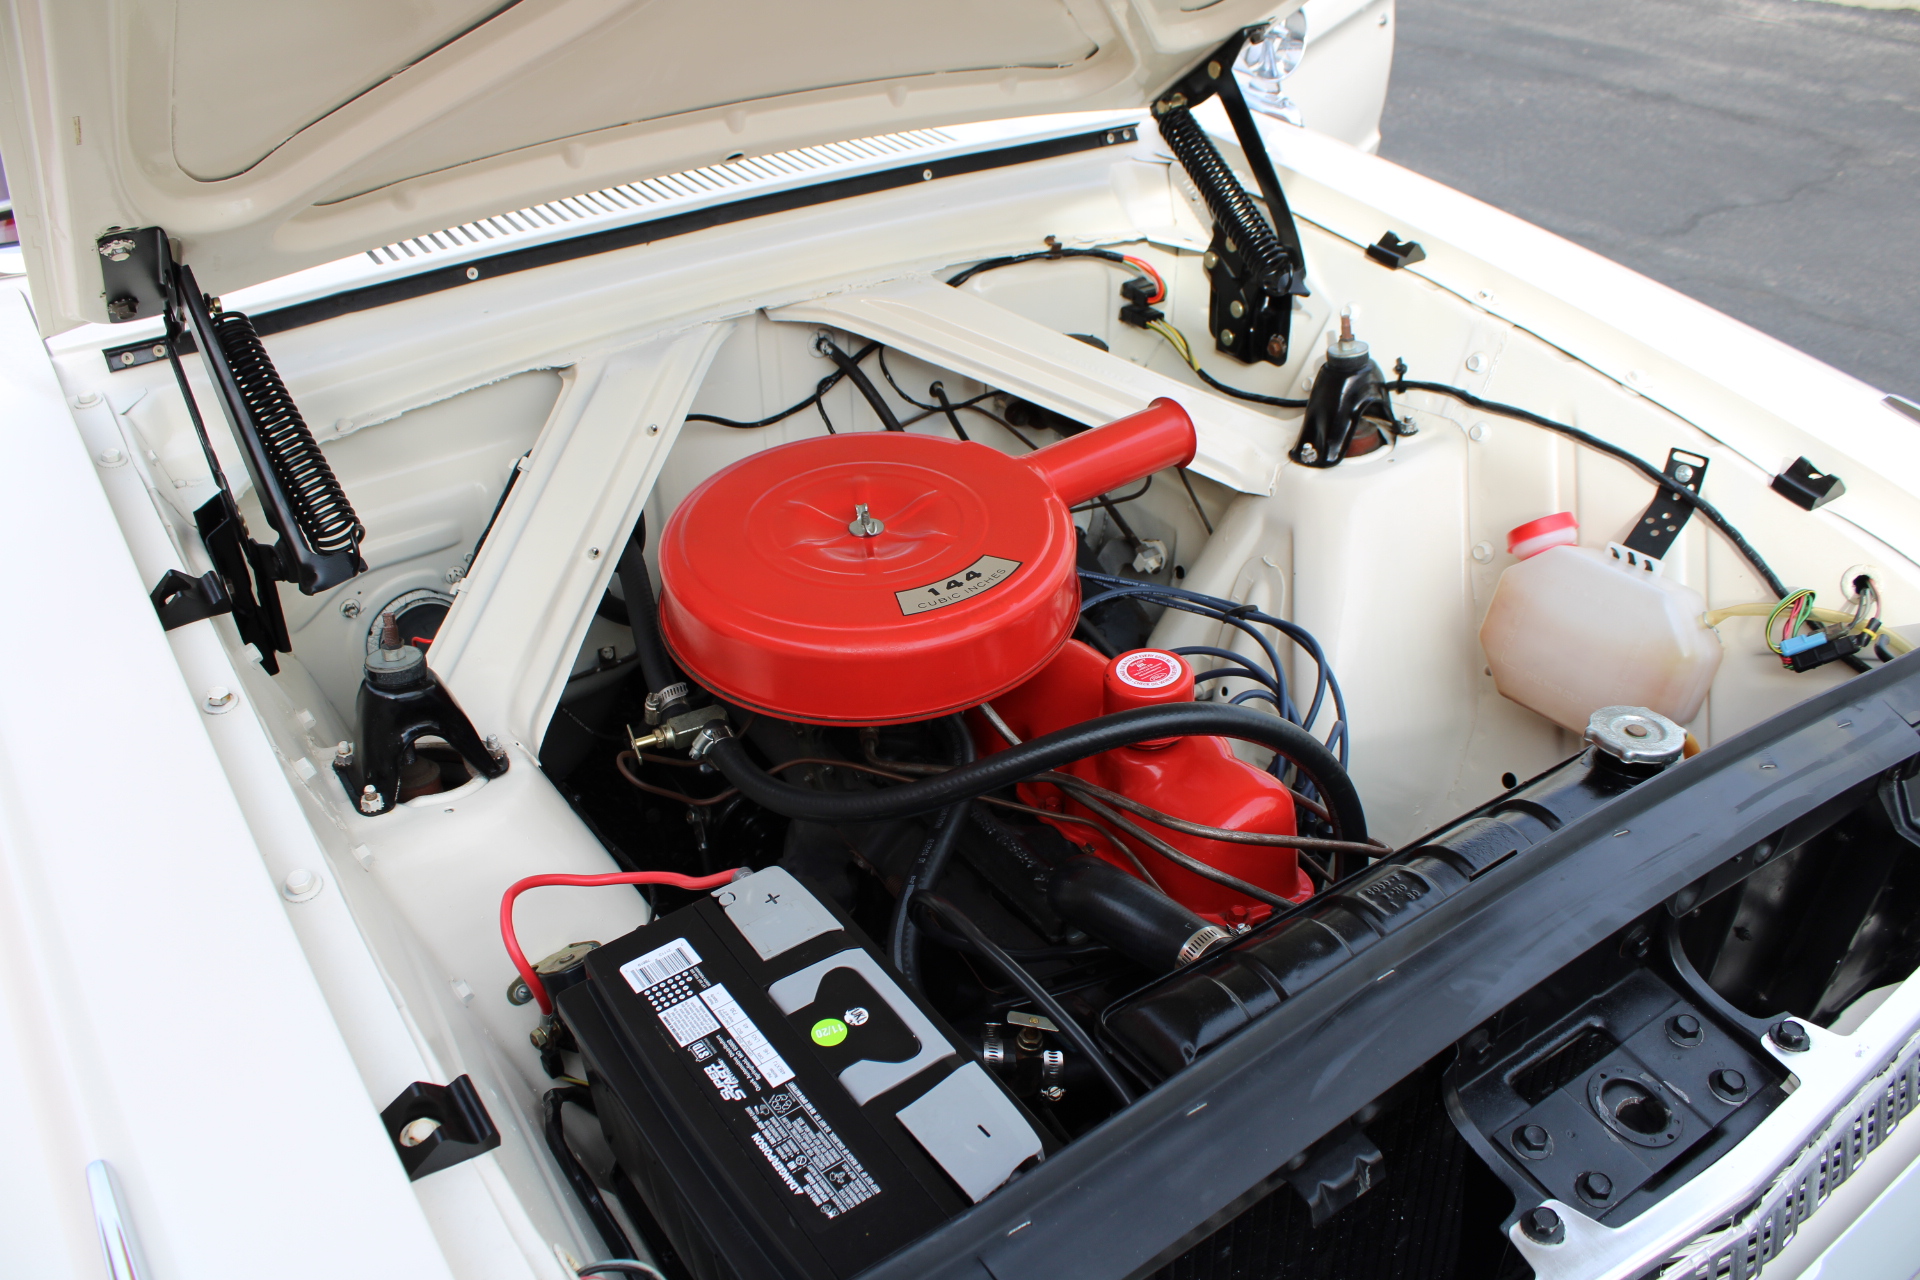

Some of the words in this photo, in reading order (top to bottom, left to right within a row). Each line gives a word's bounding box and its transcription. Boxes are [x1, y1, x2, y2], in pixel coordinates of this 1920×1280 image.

[918, 593, 960, 608] CUBIC
[965, 568, 1006, 593] INCHES
[928, 571, 982, 596] 144
[816, 1024, 844, 1038] 11/20
[692, 1043, 709, 1058] STD
[716, 1035, 734, 1057] Distributors
[733, 1056, 751, 1079] Automotive
[704, 1066, 730, 1100] SUPER
[711, 1064, 746, 1100] START
[750, 1078, 761, 1091] Ozark
[750, 1132, 799, 1190] DANGER/POISON
